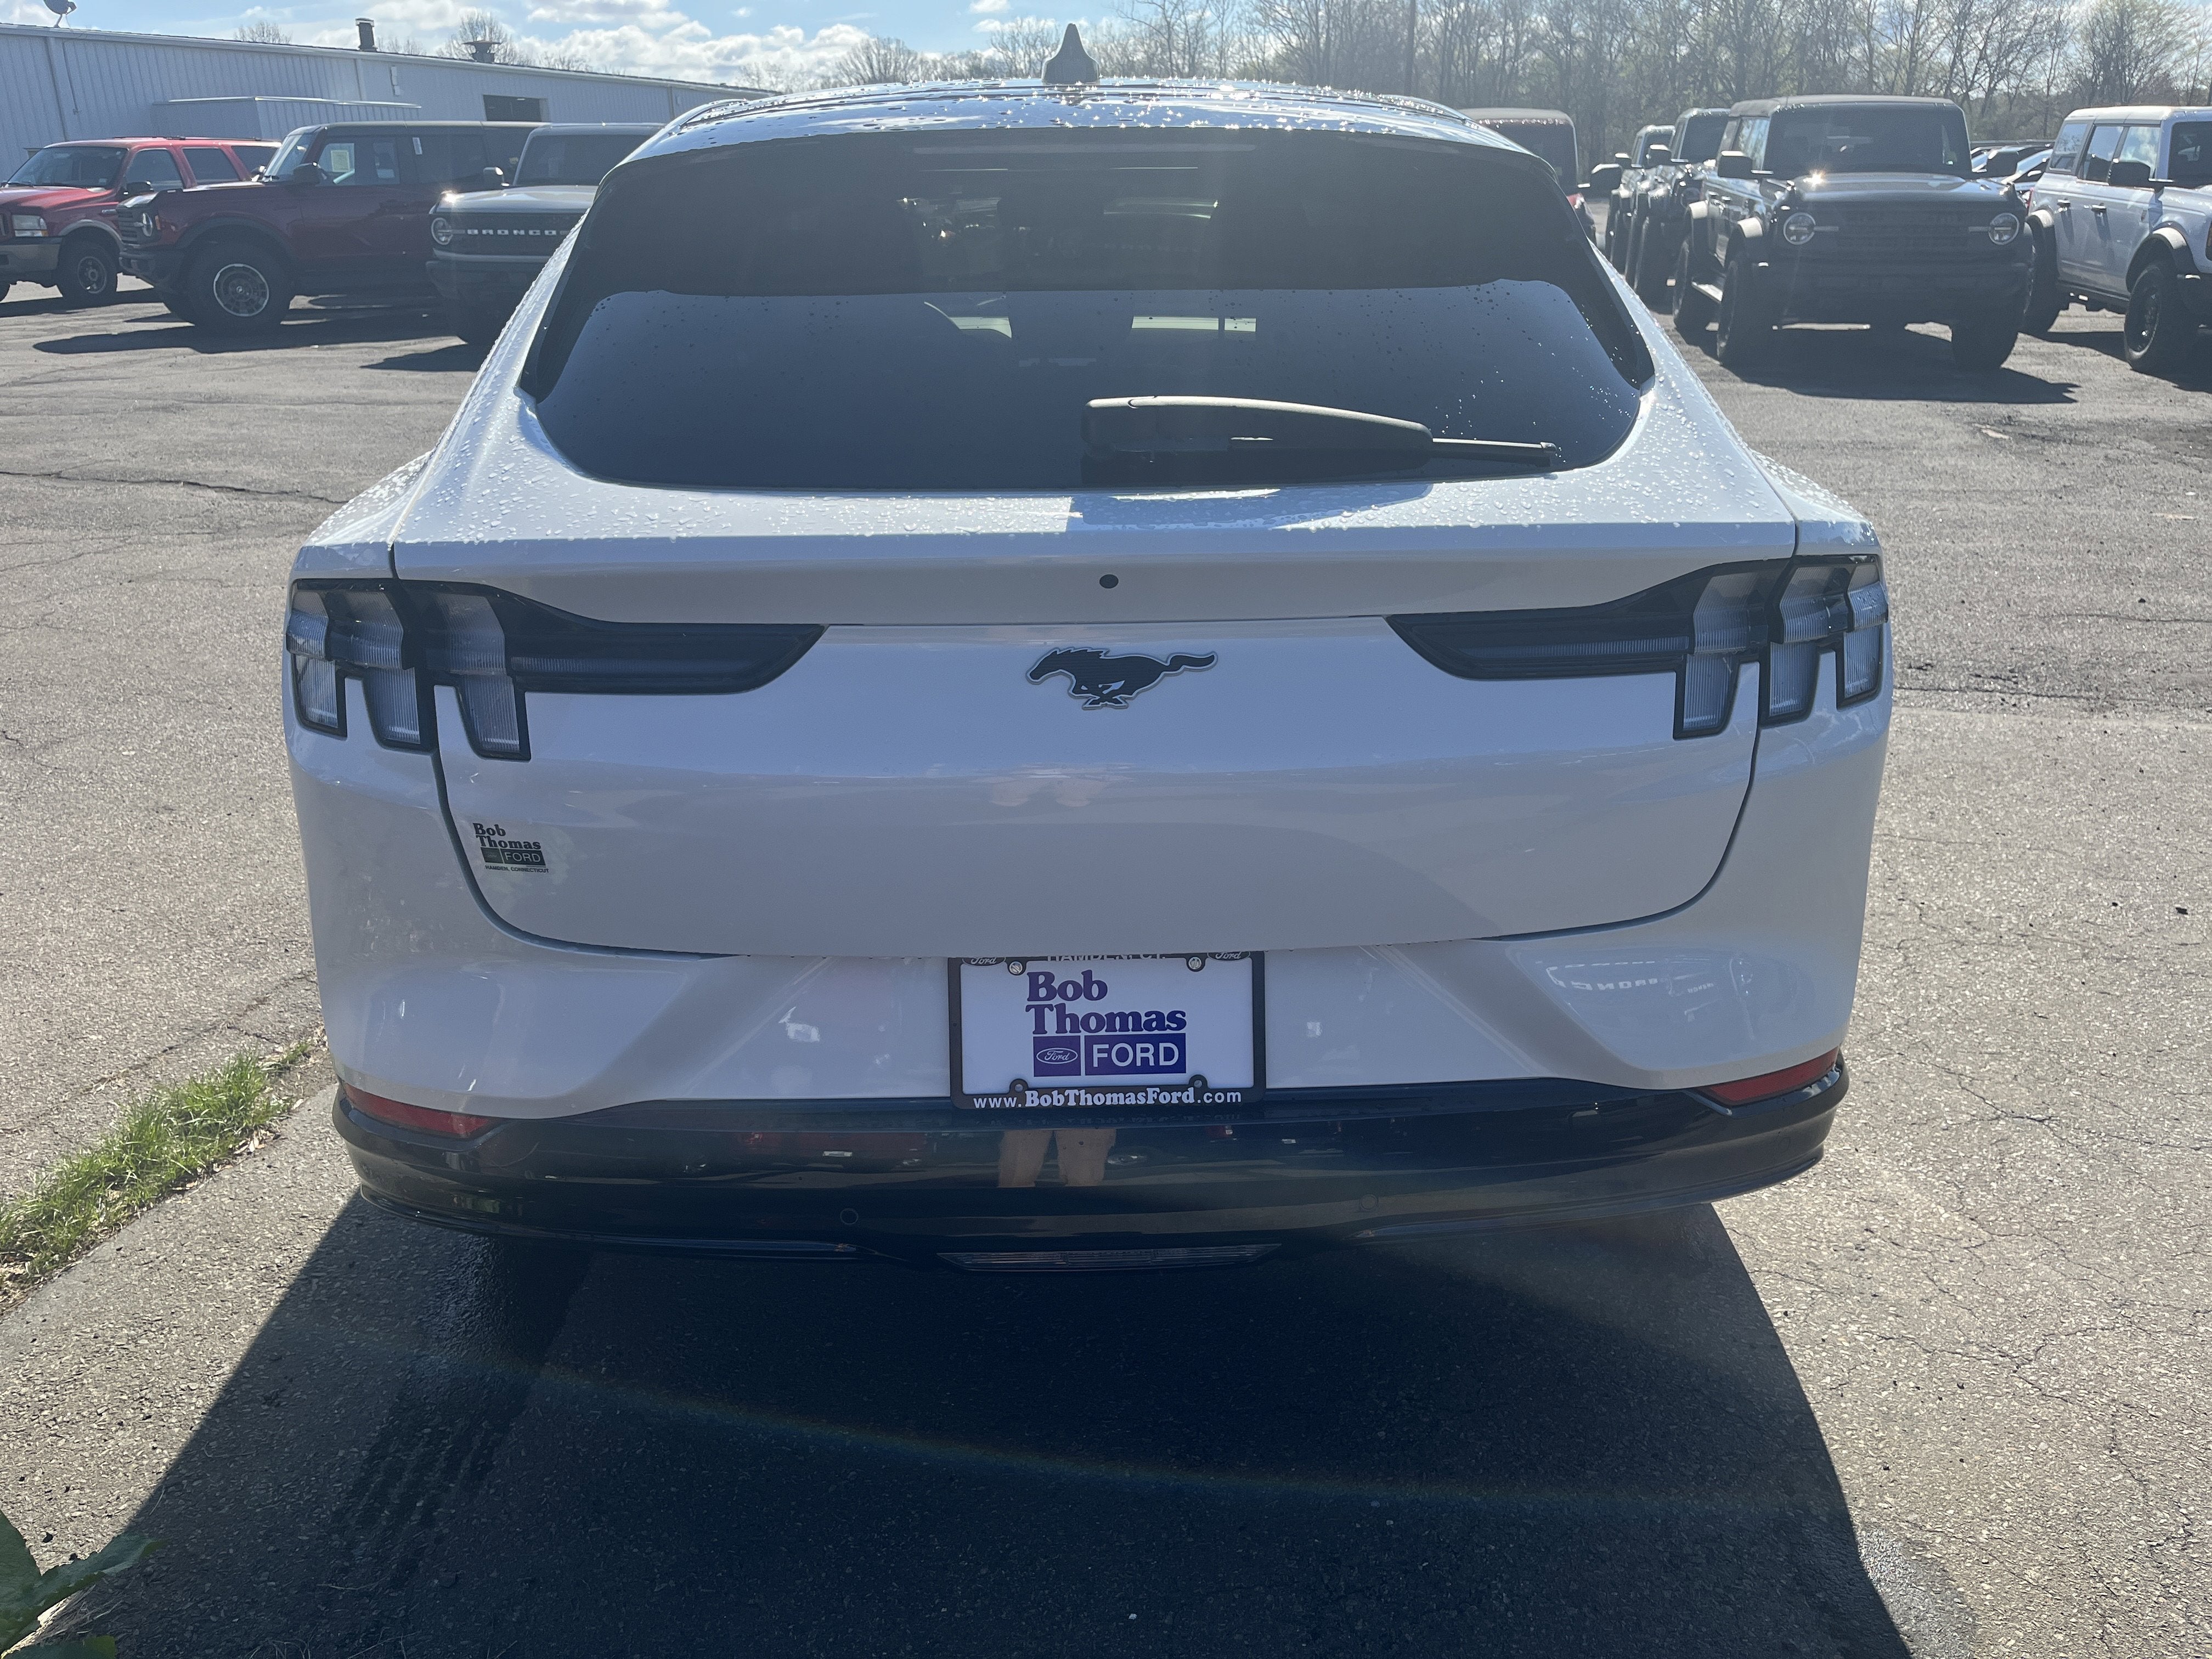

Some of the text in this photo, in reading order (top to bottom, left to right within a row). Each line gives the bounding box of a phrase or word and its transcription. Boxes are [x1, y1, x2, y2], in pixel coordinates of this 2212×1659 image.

[472, 822, 506, 837] Bob
[476, 835, 541, 850] Thomas
[504, 852, 541, 862] FORD
[1026, 969, 1108, 1002] Bob
[1025, 1003, 1187, 1035] Thomas
[1043, 1042, 1179, 1068] Ford FORD
[973, 1087, 1242, 1109] www.BobThomasFord.com
